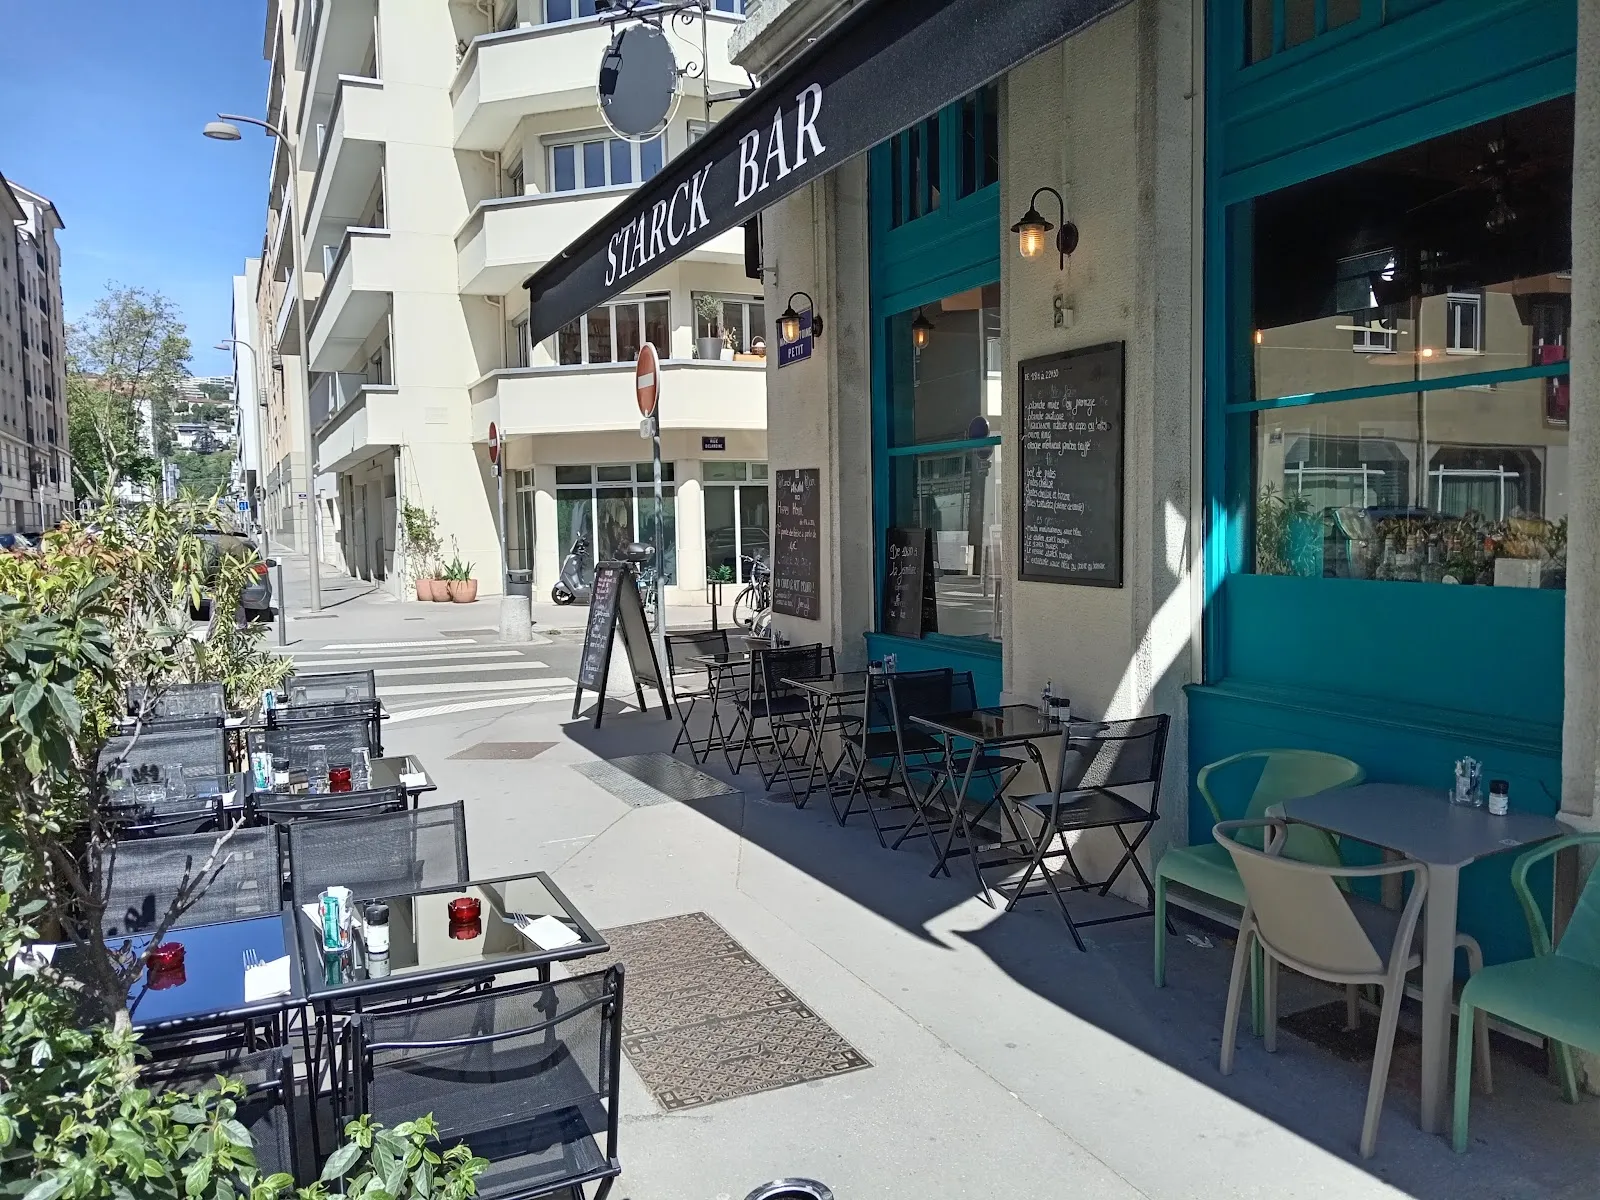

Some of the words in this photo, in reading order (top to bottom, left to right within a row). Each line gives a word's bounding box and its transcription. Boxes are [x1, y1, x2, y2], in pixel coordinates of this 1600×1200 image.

[604, 161, 713, 287] STARCK
[734, 82, 826, 207] BAR
[788, 344, 804, 358] PETIT
